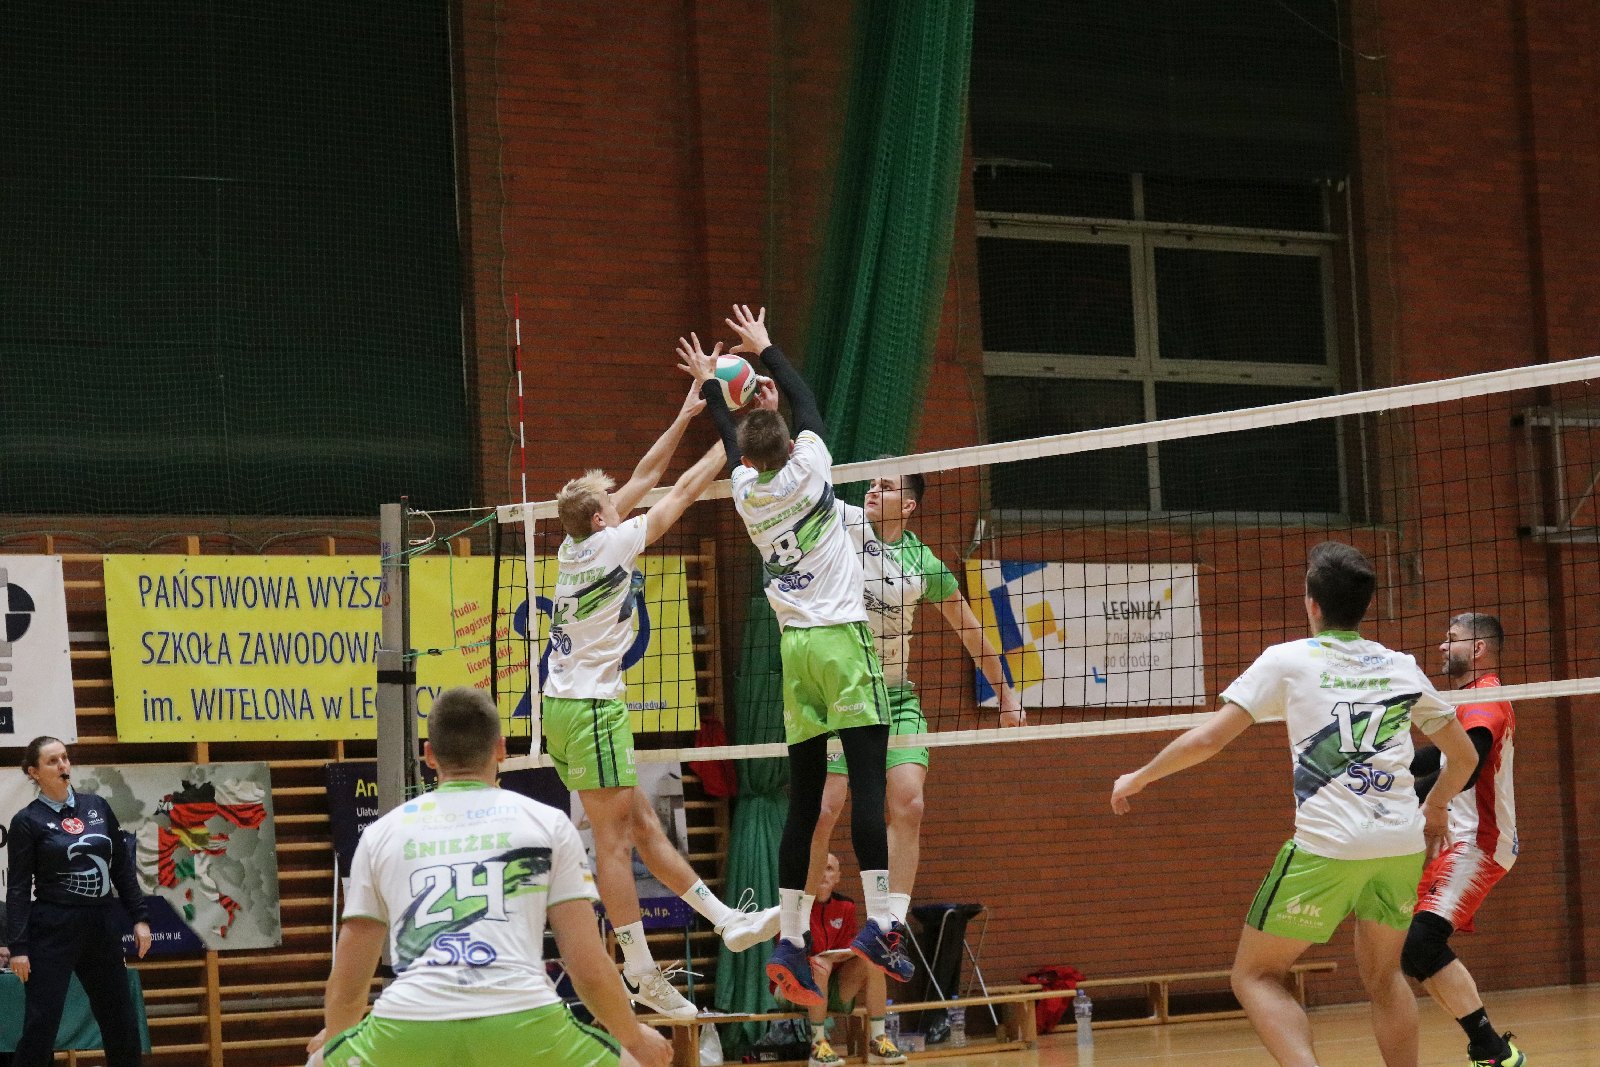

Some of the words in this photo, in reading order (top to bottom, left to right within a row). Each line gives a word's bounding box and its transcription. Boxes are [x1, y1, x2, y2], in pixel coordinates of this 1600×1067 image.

[771, 530, 804, 567] 8
[138, 569, 300, 609] PAŃSTWOWA
[308, 570, 382, 608] WYŻSZ
[1103, 601, 1162, 620] LEGNICA
[142, 631, 232, 665] SZKOŁA
[239, 631, 383, 664] ZAWODOWA
[143, 689, 182, 721] im.
[191, 688, 314, 721] WITELONA
[322, 696, 342, 719] w
[1330, 701, 1387, 753] 17
[422, 805, 517, 825] eco-team
[403, 832, 513, 860] ŚNIEŻEK
[409, 861, 509, 929] 24
[173, 931, 182, 940] UE
